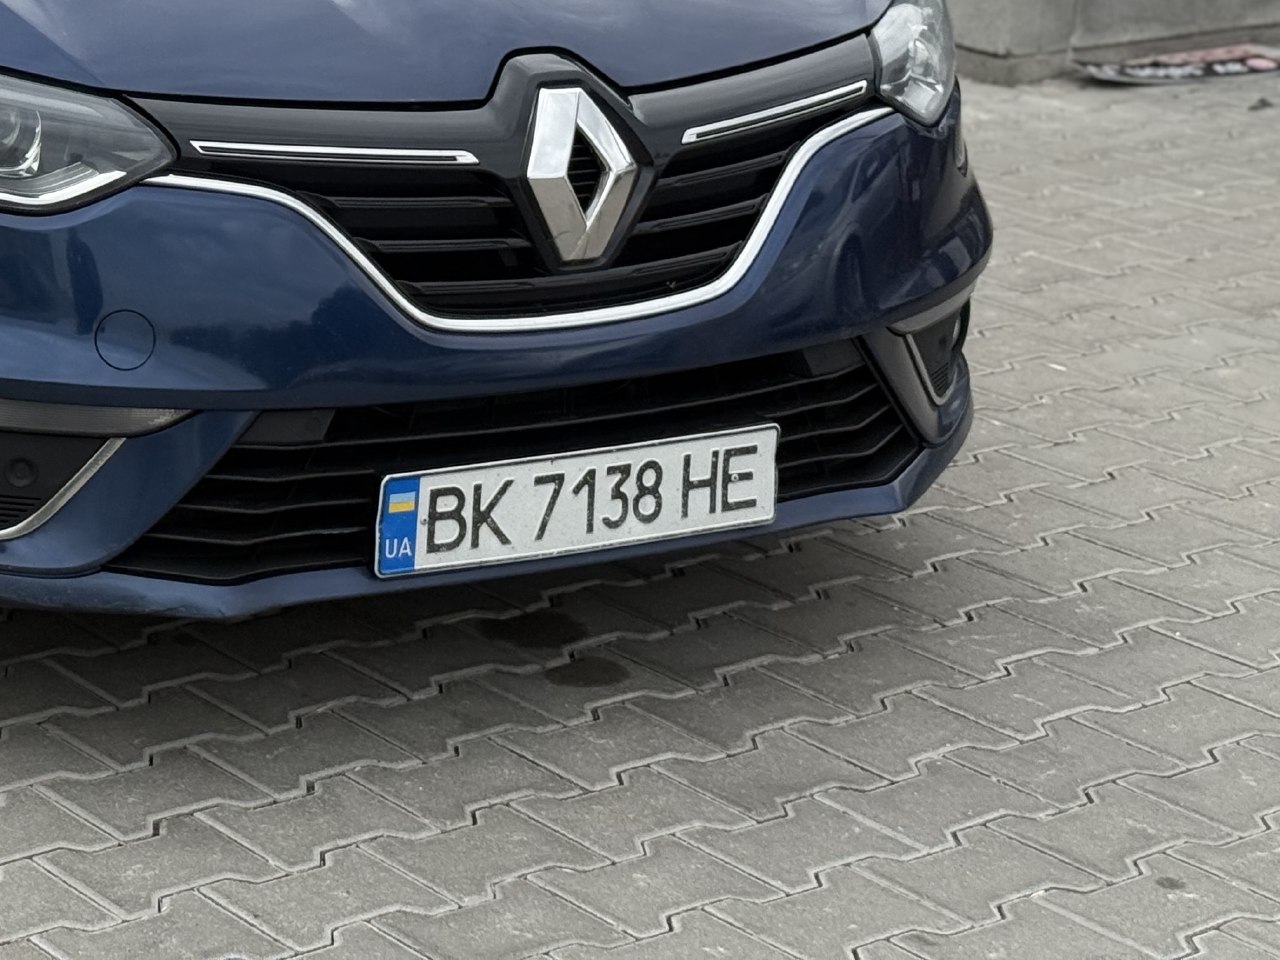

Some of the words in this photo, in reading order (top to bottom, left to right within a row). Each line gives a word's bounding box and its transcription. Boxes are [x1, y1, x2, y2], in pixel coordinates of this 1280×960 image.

[426, 479, 514, 555] BK
[533, 459, 663, 542] 7138
[681, 444, 759, 520] HE
[385, 538, 412, 559] UA
